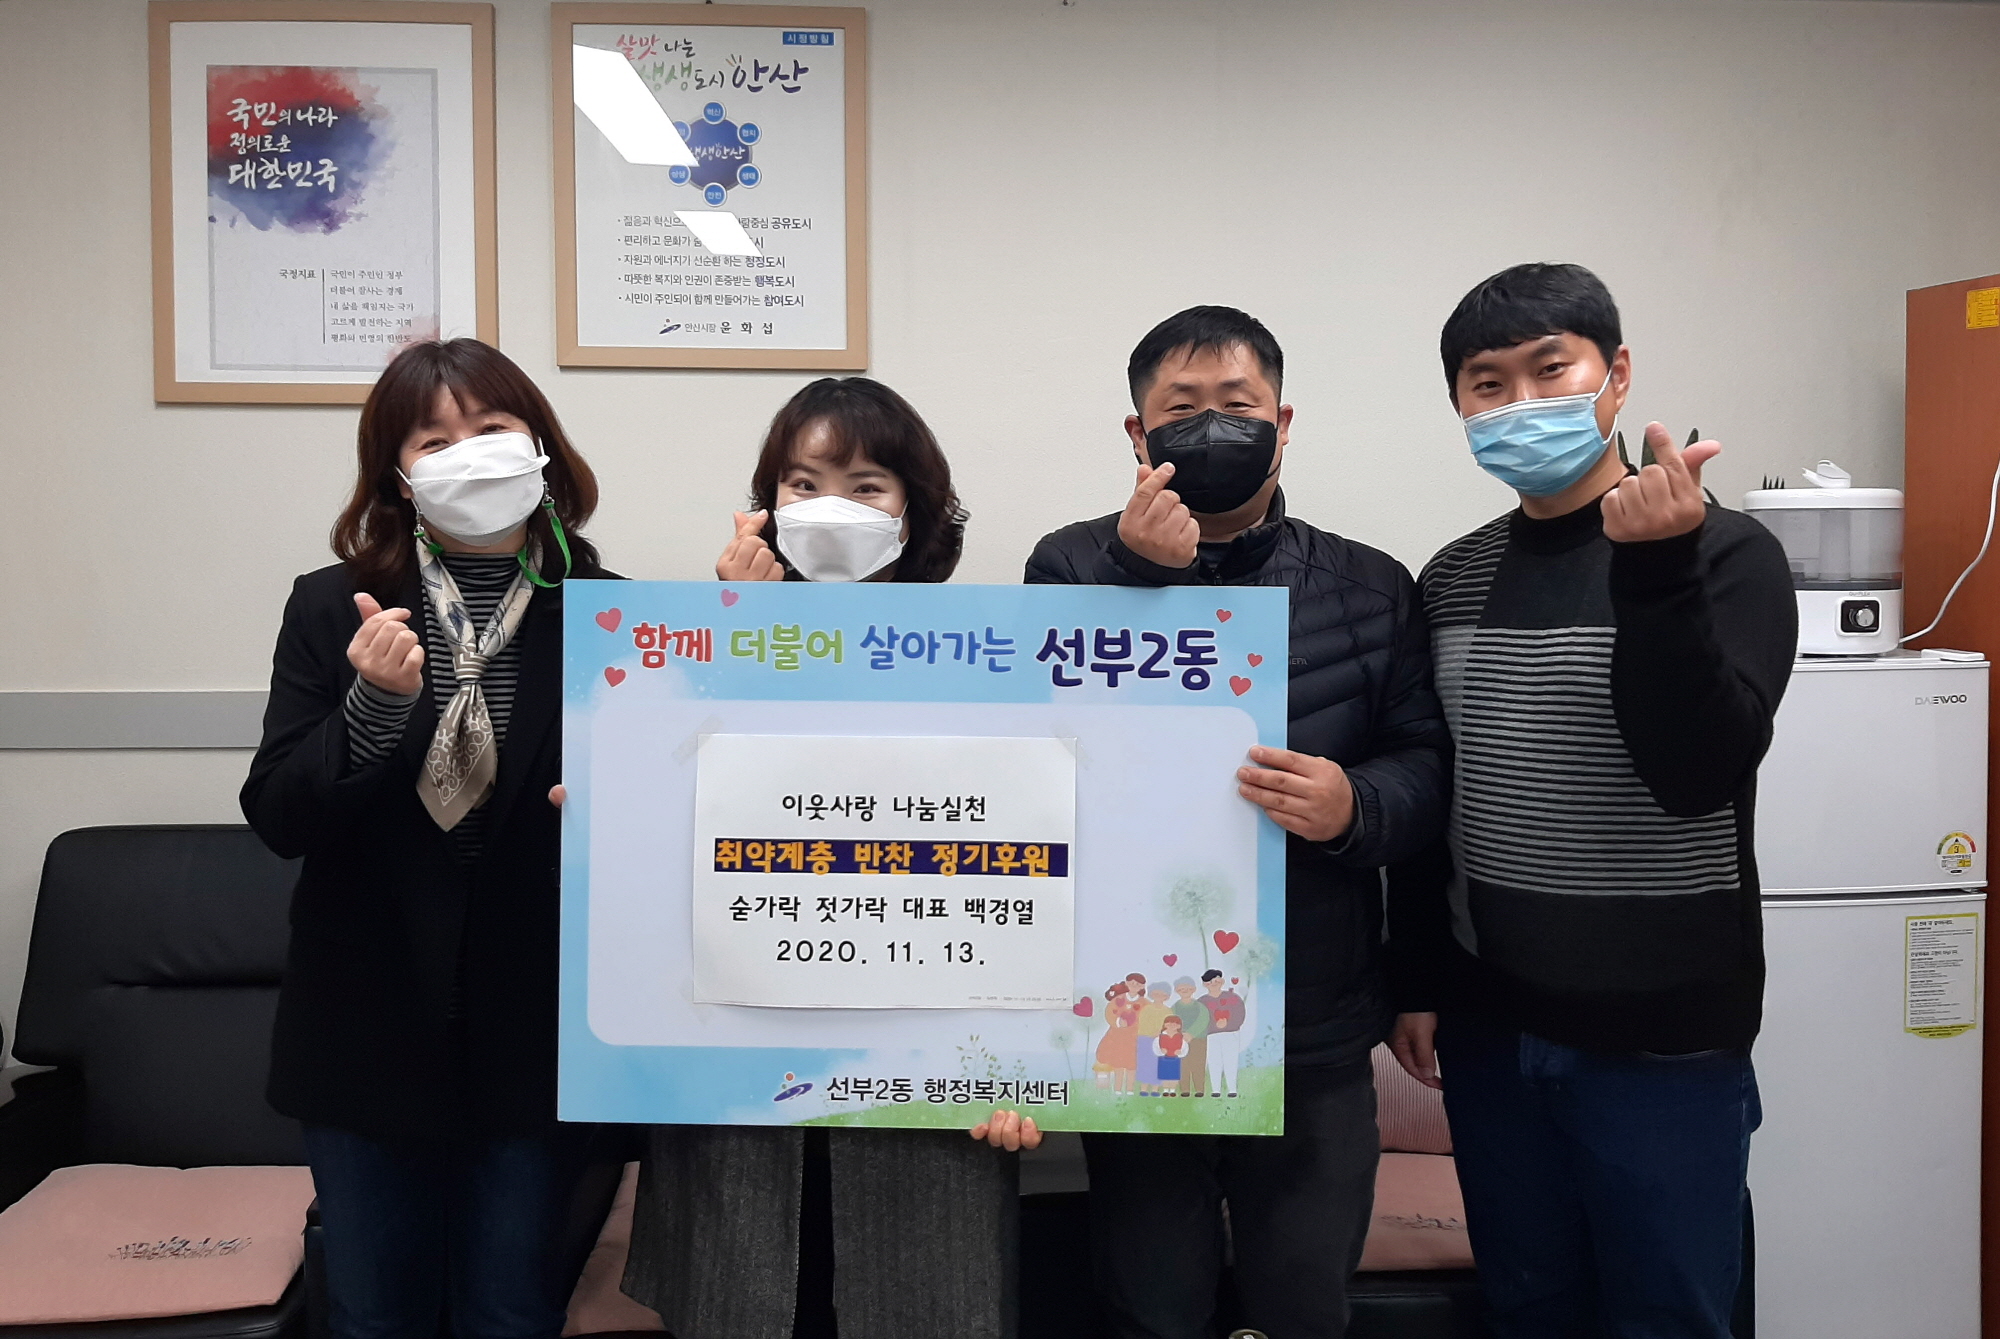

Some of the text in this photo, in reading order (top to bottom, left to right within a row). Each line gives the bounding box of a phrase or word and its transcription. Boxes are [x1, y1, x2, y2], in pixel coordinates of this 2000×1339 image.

[617, 34, 695, 60] 살맛 나는
[788, 33, 829, 44] 시정방침
[732, 59, 809, 93] 안산
[227, 98, 338, 130] 국민의 나라
[230, 133, 291, 154] 정의로운
[228, 157, 338, 193] 대한민국
[654, 215, 687, 228] 혁신으
[738, 217, 769, 229] 람중심
[771, 217, 812, 230] 공유도시
[624, 235, 661, 246] 편리하고
[663, 235, 691, 247] 문화가
[624, 255, 652, 266] 자원과
[745, 256, 785, 269] 청정도시
[279, 268, 317, 279] 국정지표
[624, 273, 795, 288] 따뜻한 복지와 인권이 존중받는 행복도시
[624, 293, 652, 304] 시민이
[694, 294, 713, 305] 함께
[715, 294, 760, 306] 만들어가는
[764, 294, 804, 307] 참여도시
[685, 323, 716, 333] 안산시장
[632, 622, 1219, 691] 함께 더불어 살아가는 선부2동
[1290, 657, 1308, 666] EPA
[1914, 694, 1967, 706] DAEWOO
[782, 793, 987, 823] 이웃사랑 나눔실천
[715, 840, 1051, 877] 취약계층 반찬 정기후원
[729, 895, 1035, 926] 숟가락 젓가락 대표 백경열
[776, 939, 986, 966] 2020. 11. 13.
[825, 1076, 1070, 1107] 선부2동 행정복지센터
